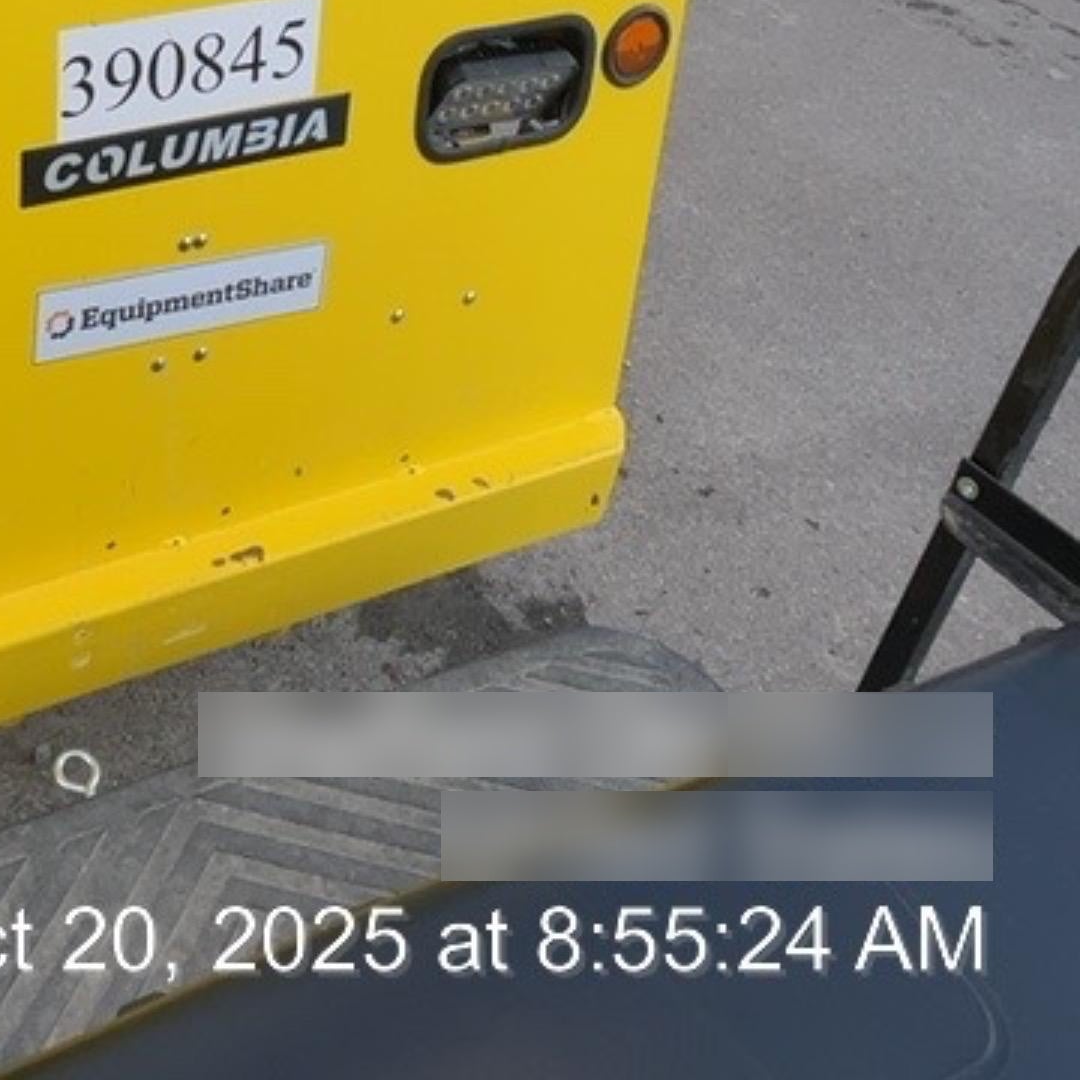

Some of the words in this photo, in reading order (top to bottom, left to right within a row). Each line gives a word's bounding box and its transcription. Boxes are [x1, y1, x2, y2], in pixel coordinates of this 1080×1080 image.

[60, 18, 308, 118] 390845
[42, 106, 330, 193] COLUMBIA
[79, 270, 314, 332] EquipmentShare
